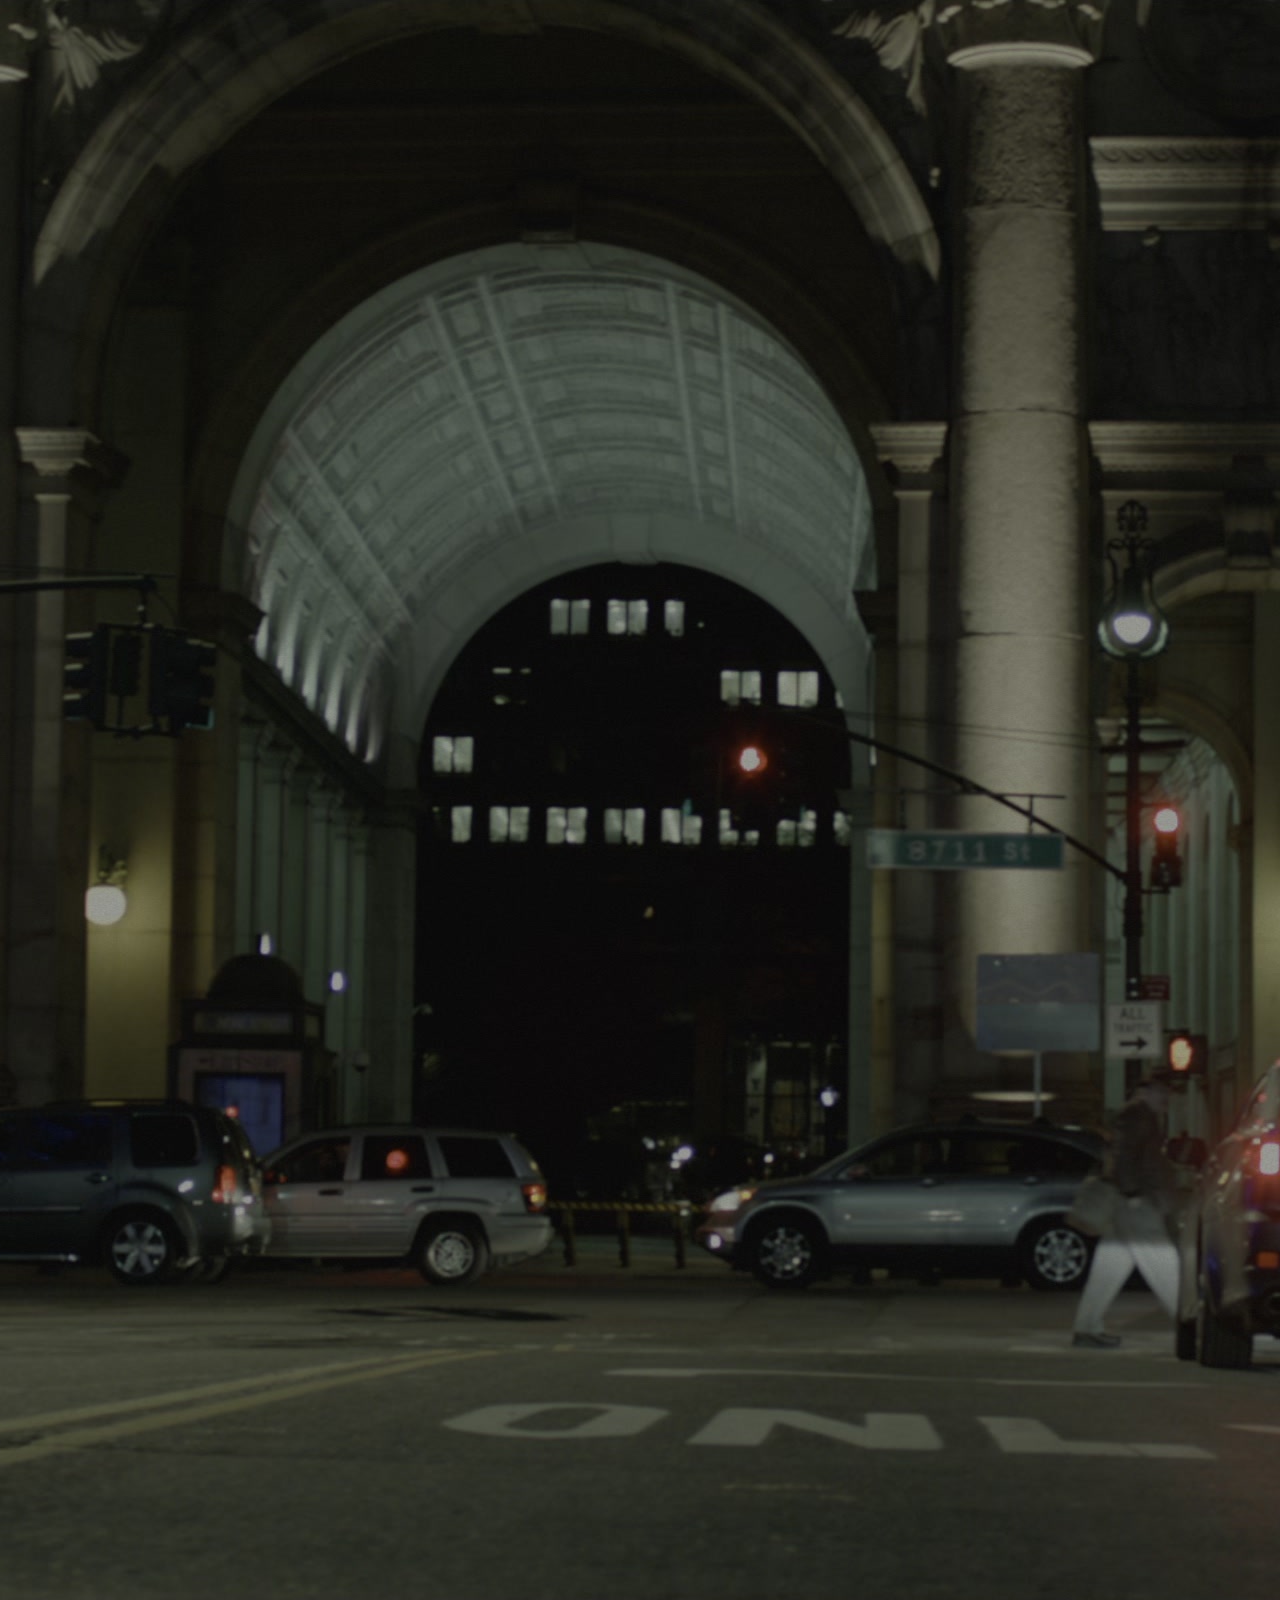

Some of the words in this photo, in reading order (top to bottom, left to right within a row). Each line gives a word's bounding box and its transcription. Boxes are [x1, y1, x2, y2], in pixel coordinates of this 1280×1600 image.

[907, 839, 987, 863] 8711
[1003, 841, 1031, 862] St
[1120, 1007, 1146, 1020] ALL
[1113, 1023, 1154, 1033] TRAFFIC
